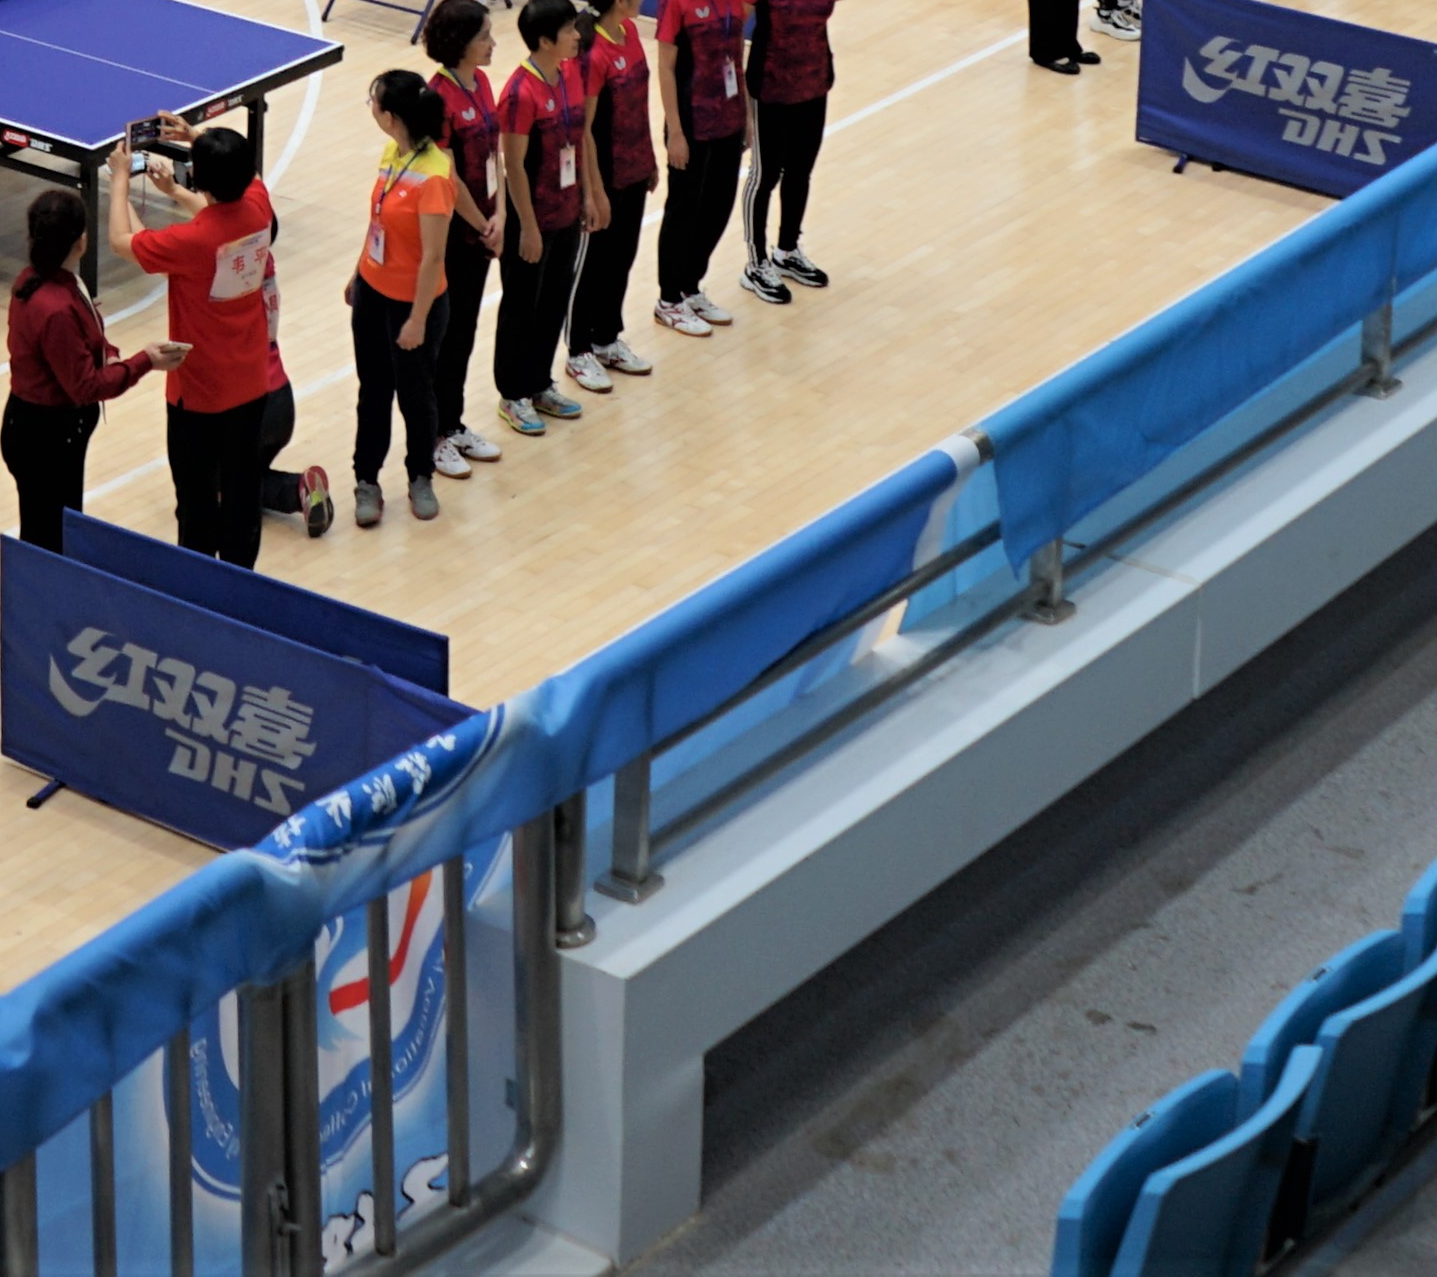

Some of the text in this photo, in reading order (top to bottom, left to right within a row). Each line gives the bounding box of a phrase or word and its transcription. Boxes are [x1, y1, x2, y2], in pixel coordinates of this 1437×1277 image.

[1184, 35, 1411, 128] 红双喜
[49, 626, 316, 771] 红双喜
[168, 736, 306, 815] DHS
